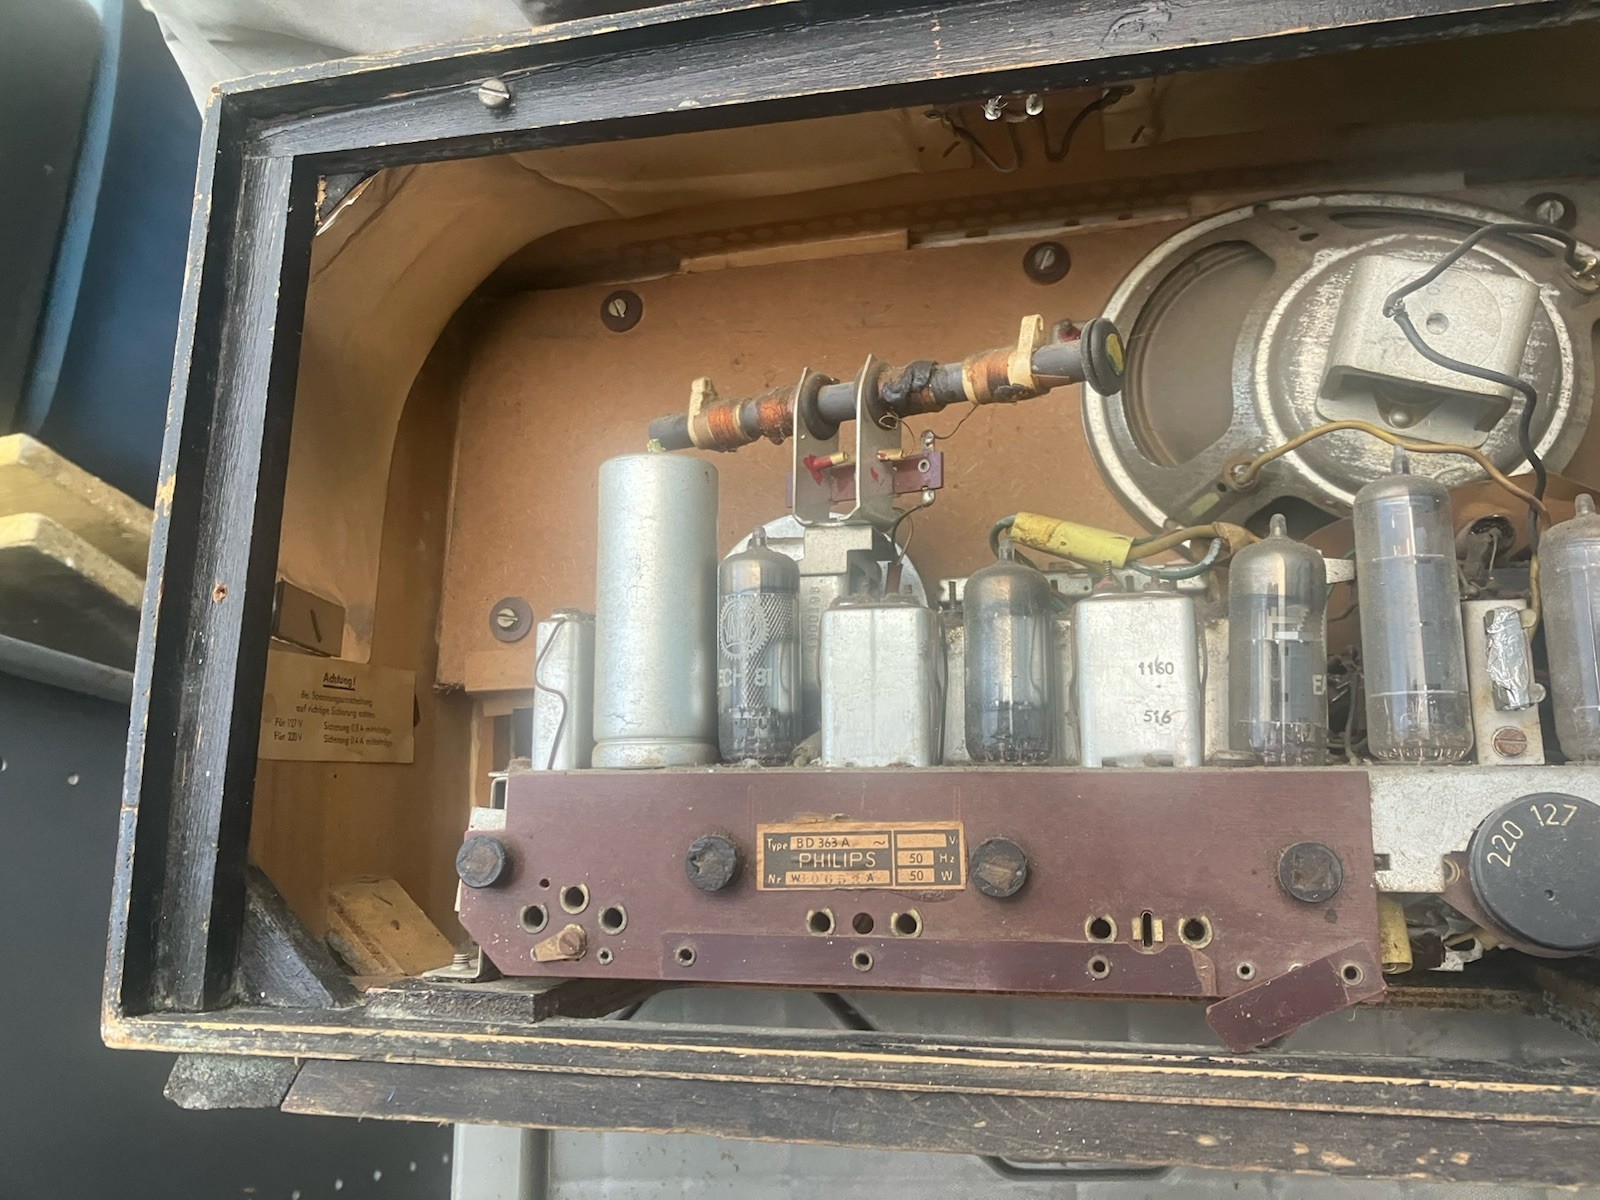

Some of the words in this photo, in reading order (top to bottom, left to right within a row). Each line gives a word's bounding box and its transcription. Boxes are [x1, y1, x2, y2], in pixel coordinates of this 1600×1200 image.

[1138, 655, 1174, 676] 1160
[323, 672, 356, 687] Achtung!
[1143, 709, 1172, 726] 516
[1530, 803, 1578, 827] 127
[767, 838, 788, 851] Type
[949, 836, 956, 845] V
[1486, 820, 1524, 868] 220
[799, 852, 876, 868] PHILIPS
[909, 853, 924, 864] 50
[768, 874, 782, 884] Nr
[909, 870, 924, 881] 50
[941, 871, 953, 881] W
